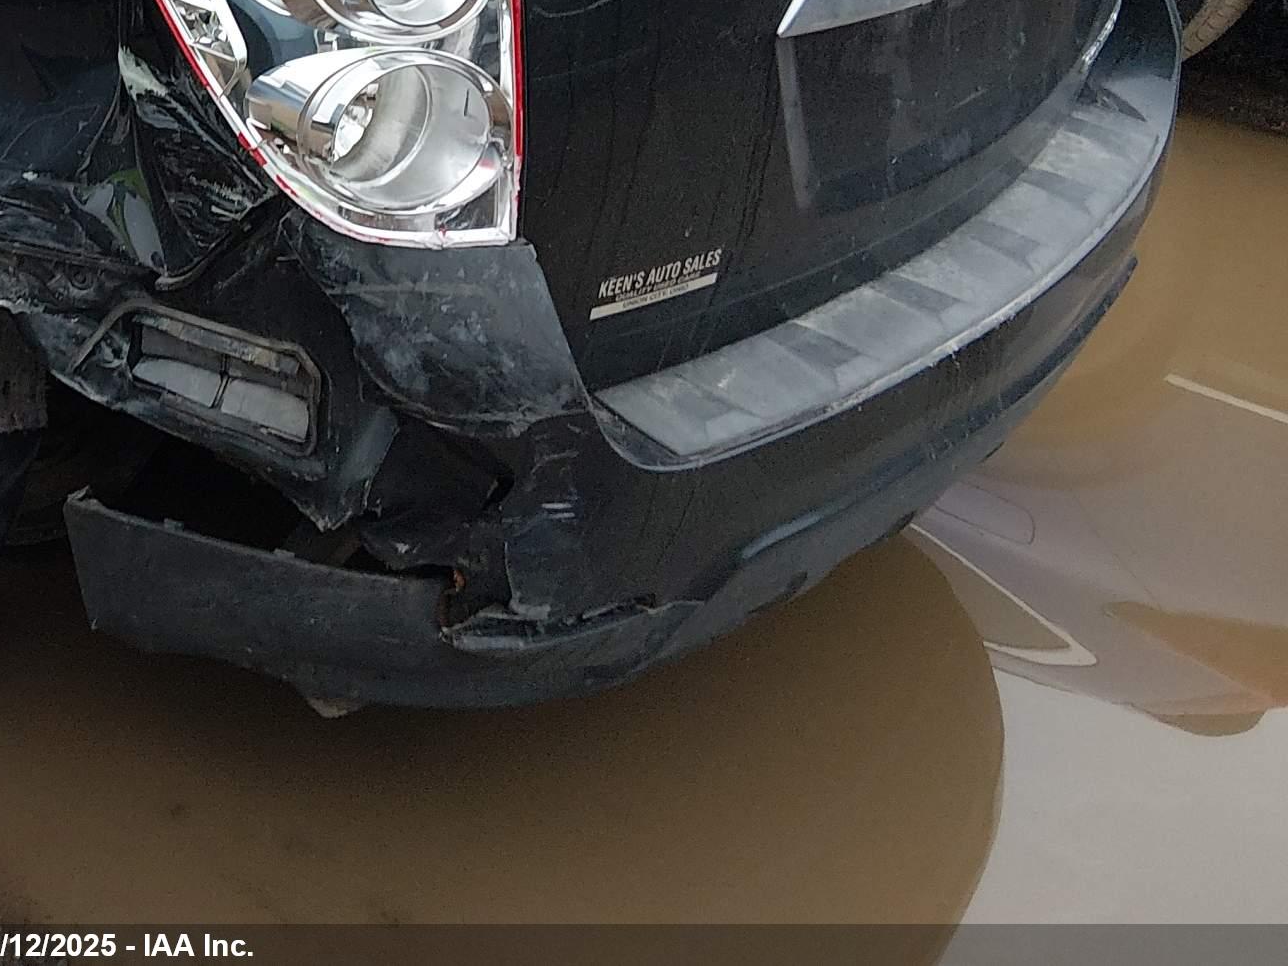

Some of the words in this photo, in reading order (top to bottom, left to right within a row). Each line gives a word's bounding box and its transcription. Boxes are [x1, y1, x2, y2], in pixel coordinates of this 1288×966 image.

[598, 270, 645, 299] KEEN'S
[645, 260, 682, 286] AUTO
[682, 248, 722, 275] SALES
